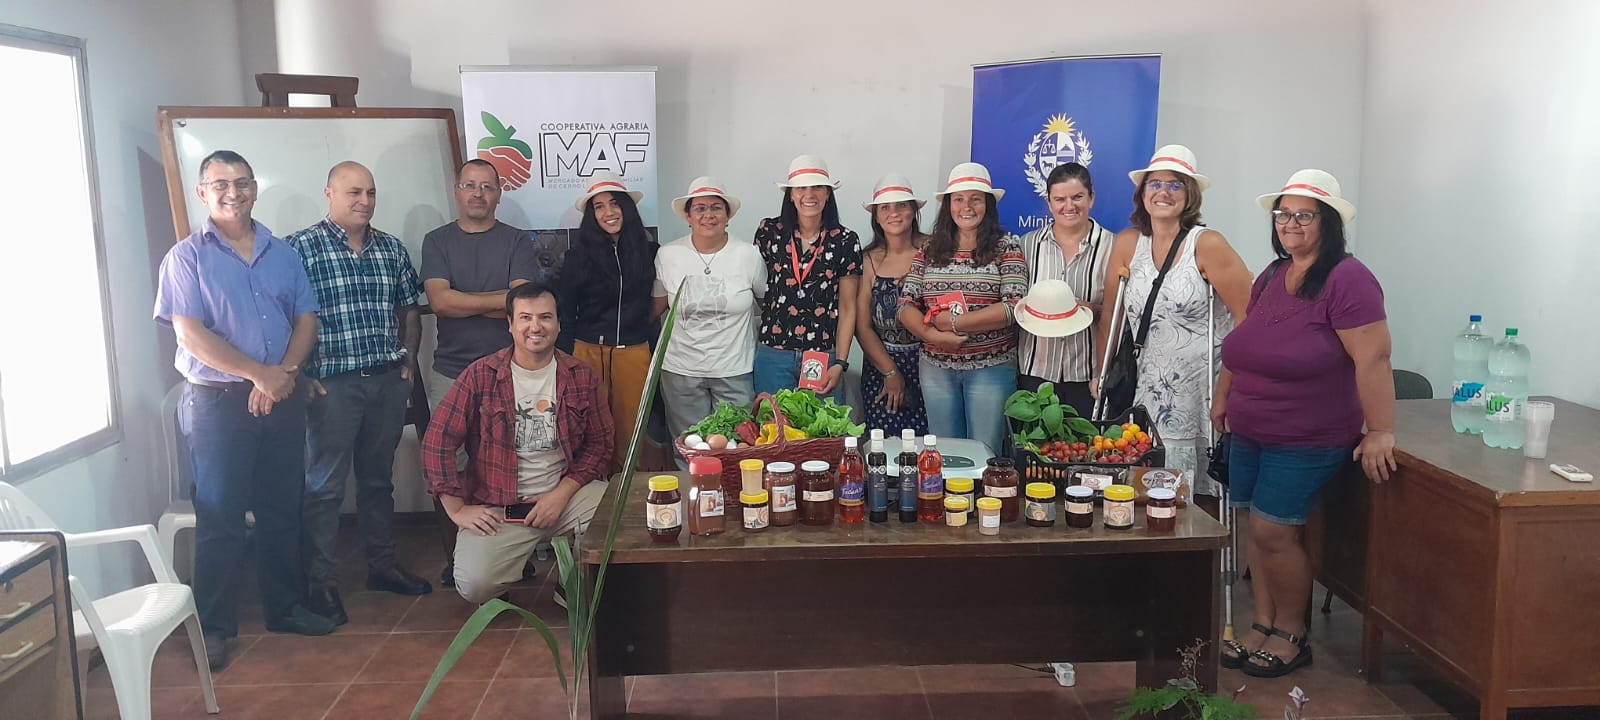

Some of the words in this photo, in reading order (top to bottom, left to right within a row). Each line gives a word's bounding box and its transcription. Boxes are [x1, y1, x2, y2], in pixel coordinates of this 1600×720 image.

[540, 122, 605, 131] COOPERATIVA
[610, 122, 649, 131] AGRARIA
[543, 132, 650, 177] MAF
[1018, 215, 1056, 228] Minis
[1453, 386, 1482, 399] ALUS
